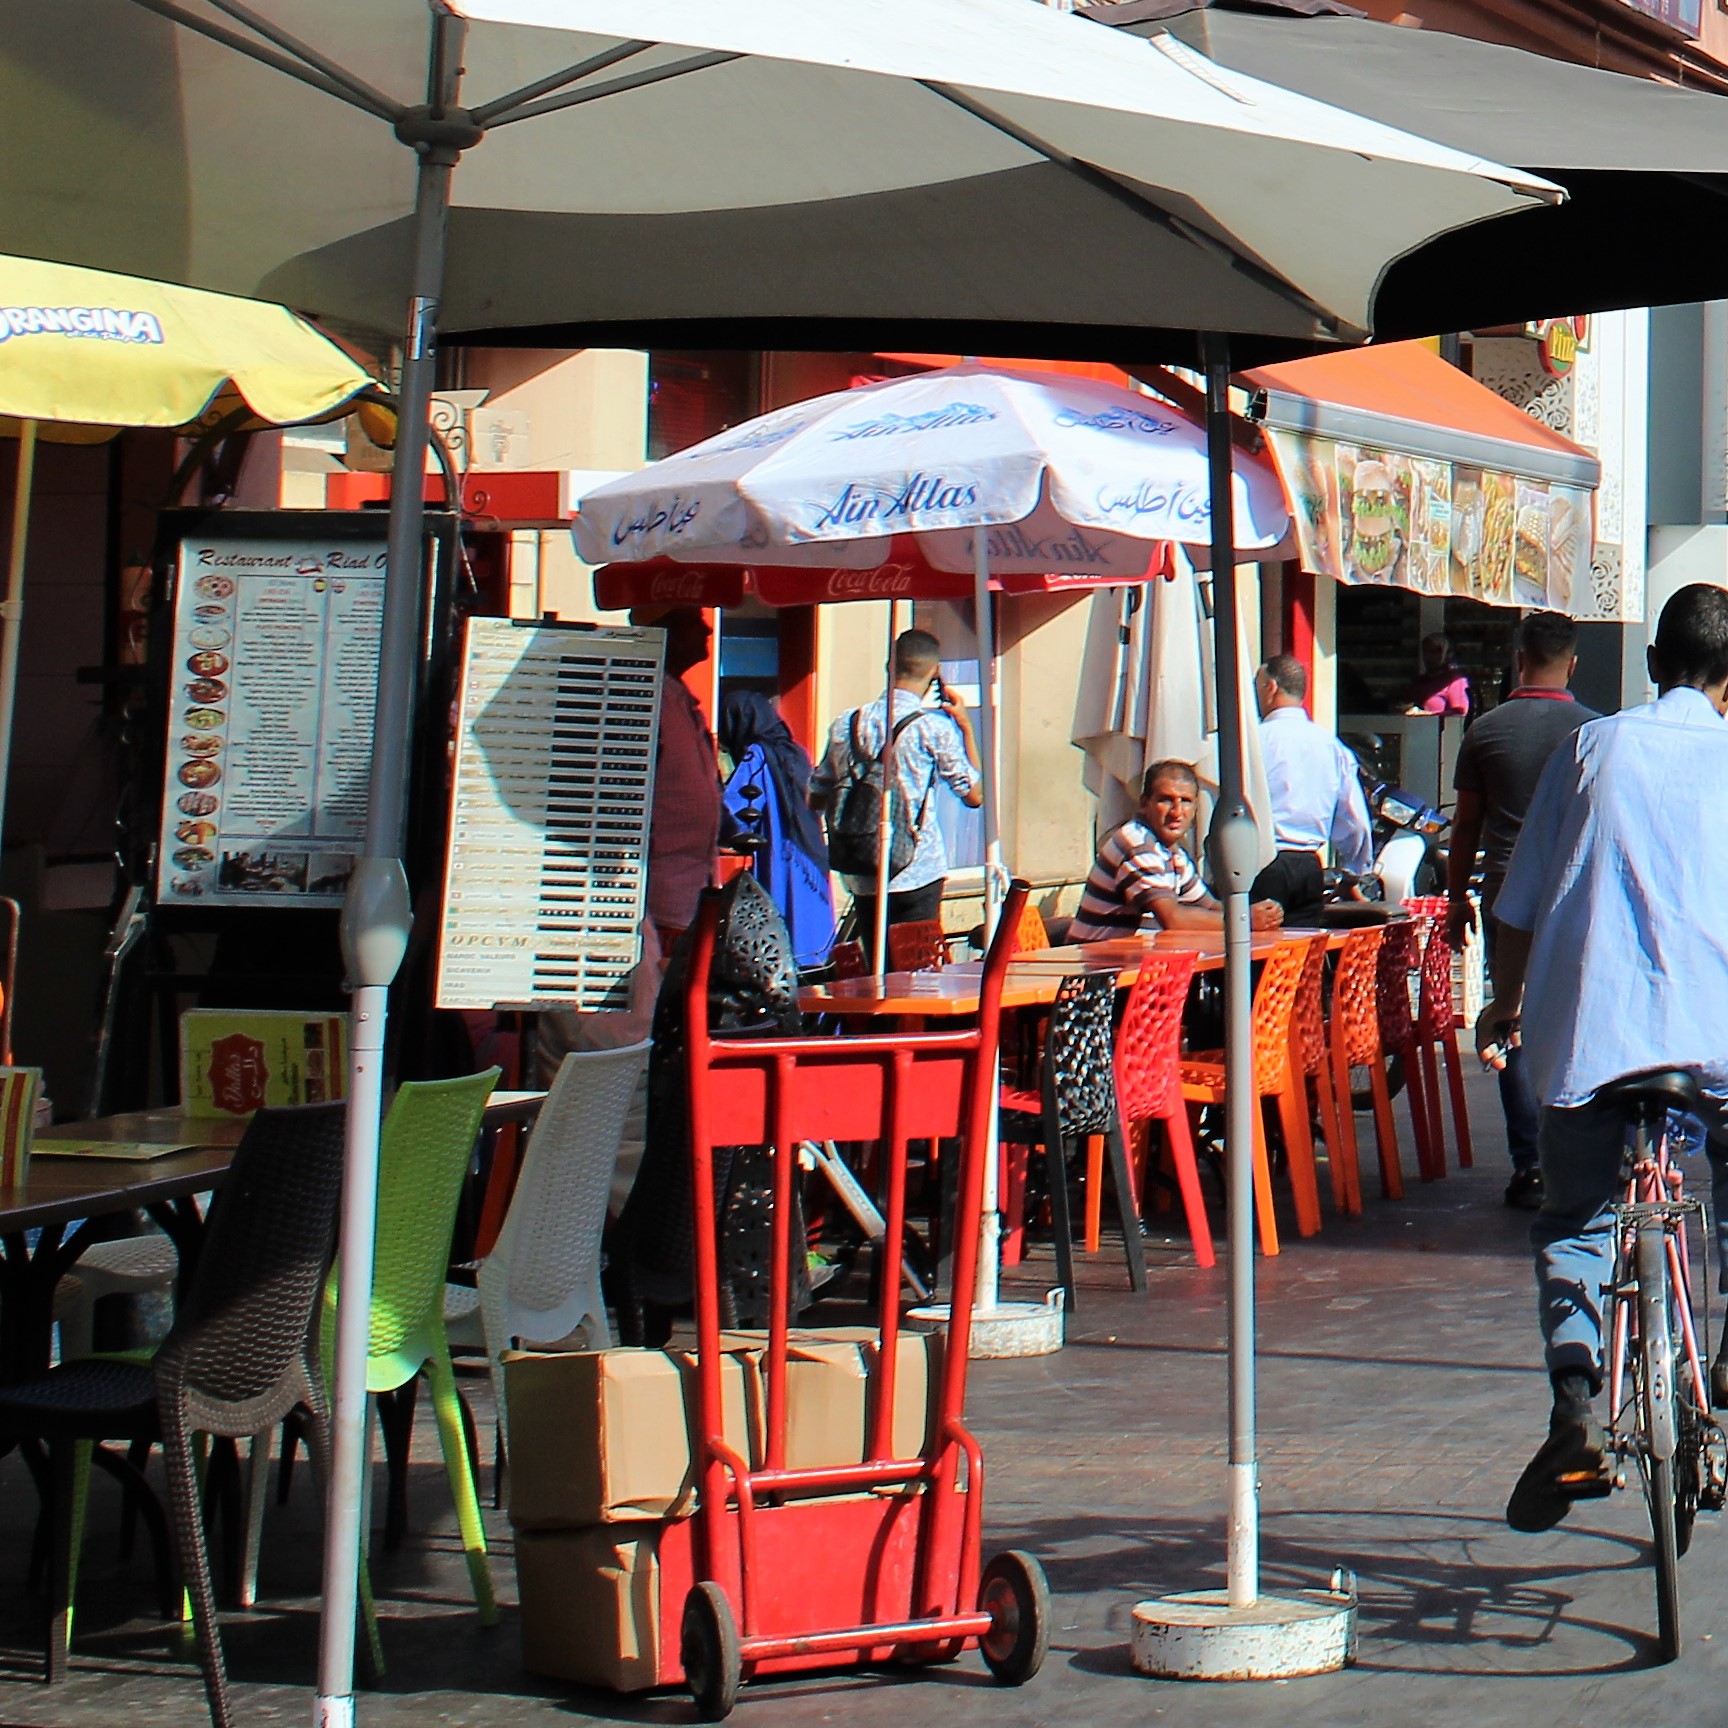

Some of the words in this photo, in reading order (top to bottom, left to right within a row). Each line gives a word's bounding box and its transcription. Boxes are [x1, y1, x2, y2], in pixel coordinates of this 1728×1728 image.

[882, 470, 979, 518] Atlas
[198, 548, 294, 567] Restaurant
[326, 551, 370, 570] Riad
